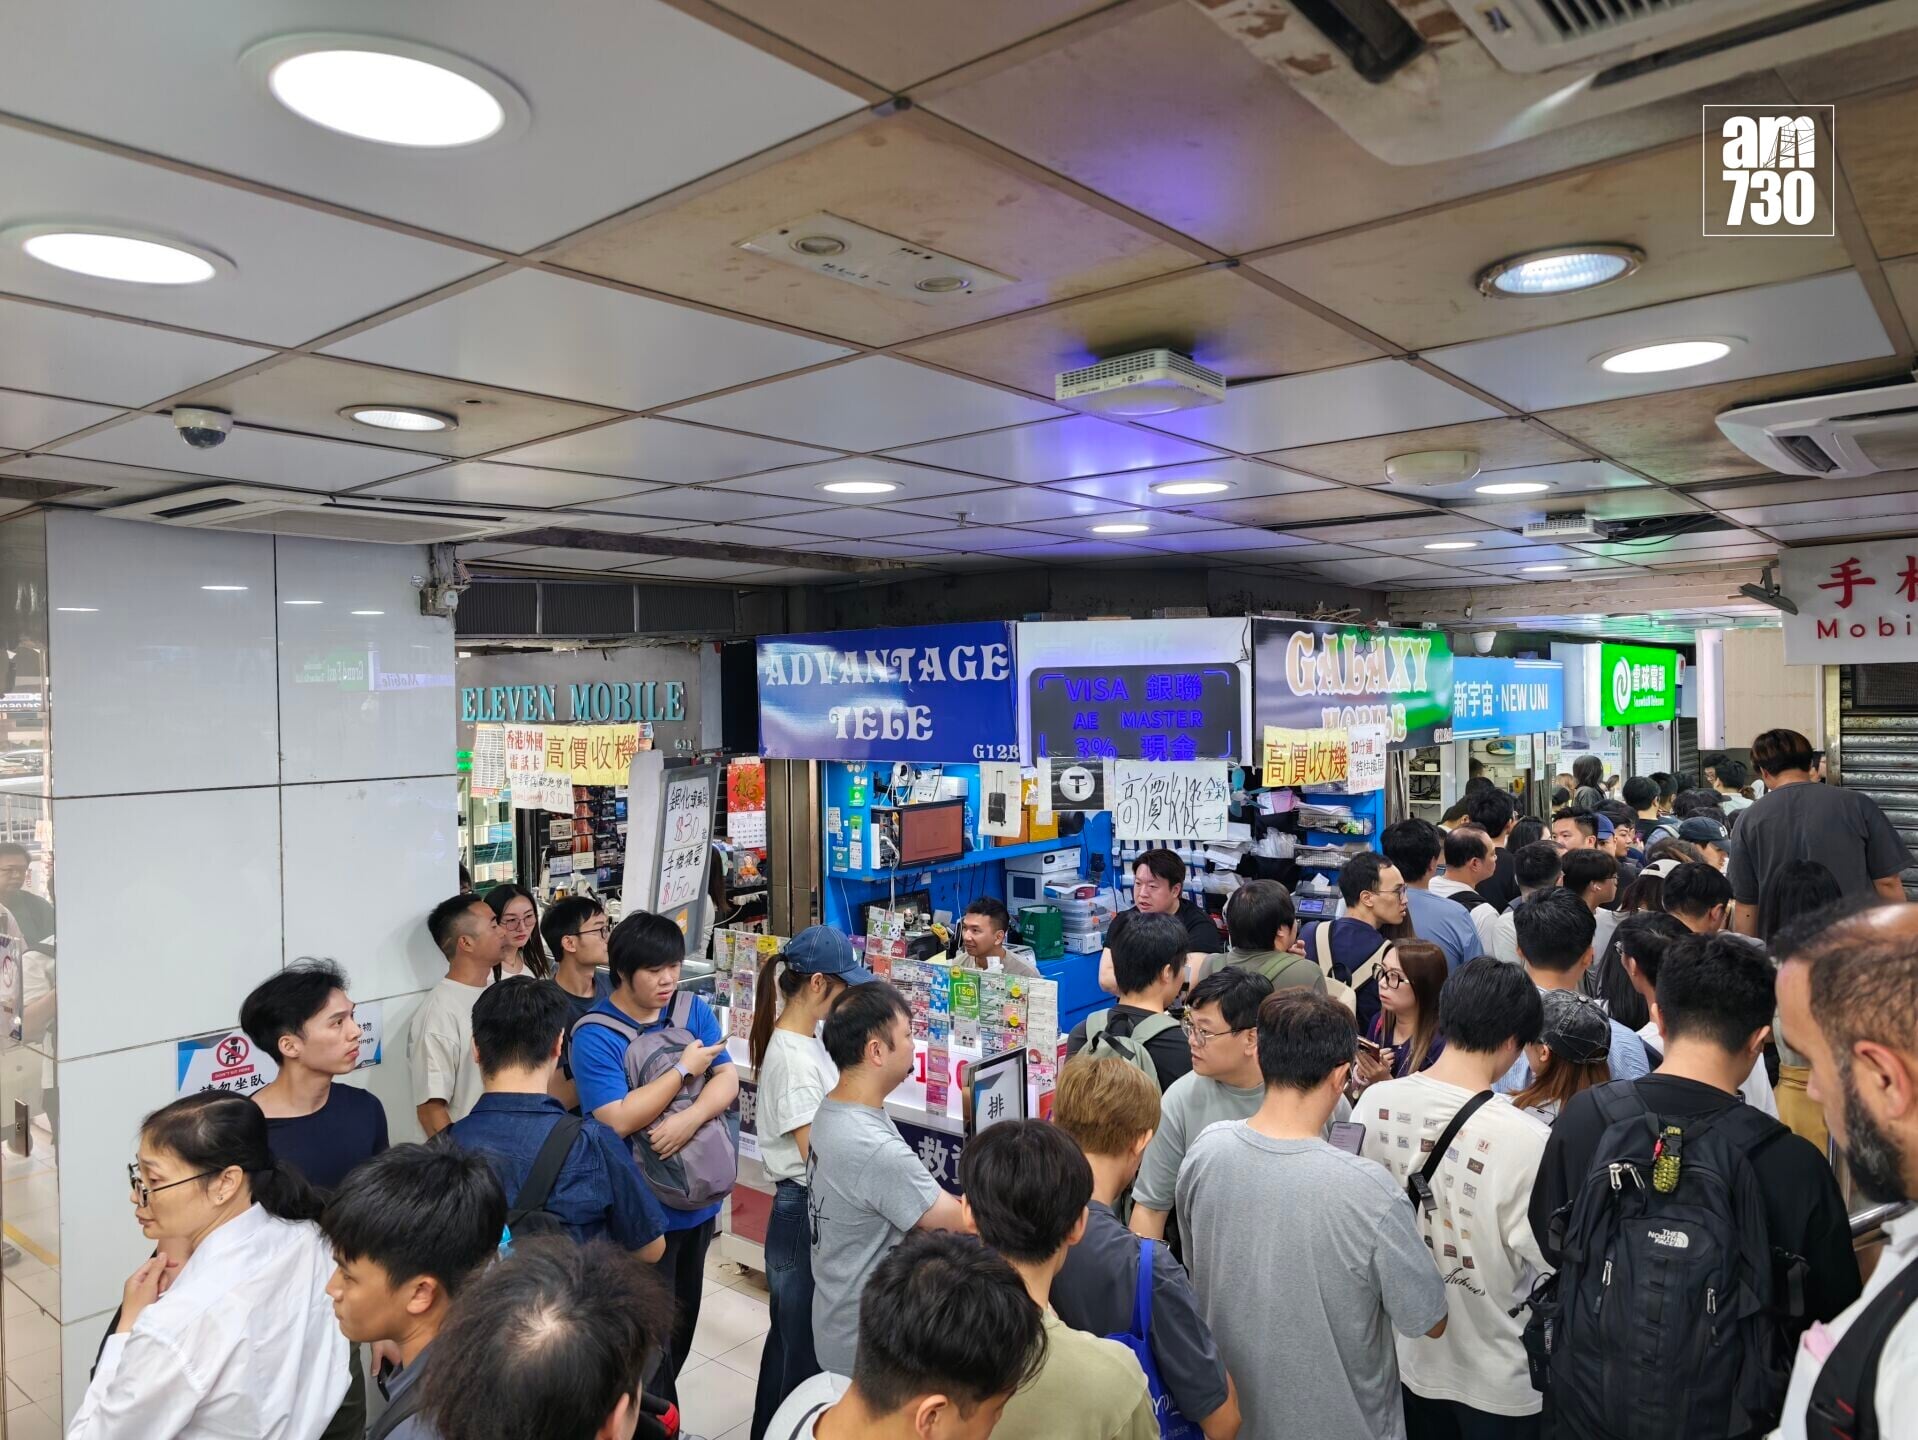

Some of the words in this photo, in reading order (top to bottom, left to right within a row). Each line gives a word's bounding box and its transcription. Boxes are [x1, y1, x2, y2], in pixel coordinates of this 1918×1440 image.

[765, 643, 1010, 686] ADVANTAGE
[1286, 631, 1431, 696] GALAXY
[461, 685, 557, 722] ELEVEN
[569, 680, 686, 721] MOBILE
[1066, 677, 1129, 702] VISA
[1146, 673, 1203, 702] 銀聯
[1454, 680, 1493, 718] 新宇宙
[1501, 684, 1527, 712] NEW
[1530, 683, 1549, 711] UNI
[829, 704, 934, 741] TELE
[1073, 712, 1099, 730] AE
[1120, 710, 1203, 729] MASTER
[546, 735, 638, 770] 高價收機
[1075, 738, 1118, 758] 3%
[1142, 735, 1197, 762] 現金
[1266, 738, 1347, 785] 高價收機
[987, 1093, 1005, 1120] 排
[1647, 1230, 1677, 1243] NORTH
[1654, 1238, 1677, 1247] FACE
[1662, 1228, 1678, 1237] THE
